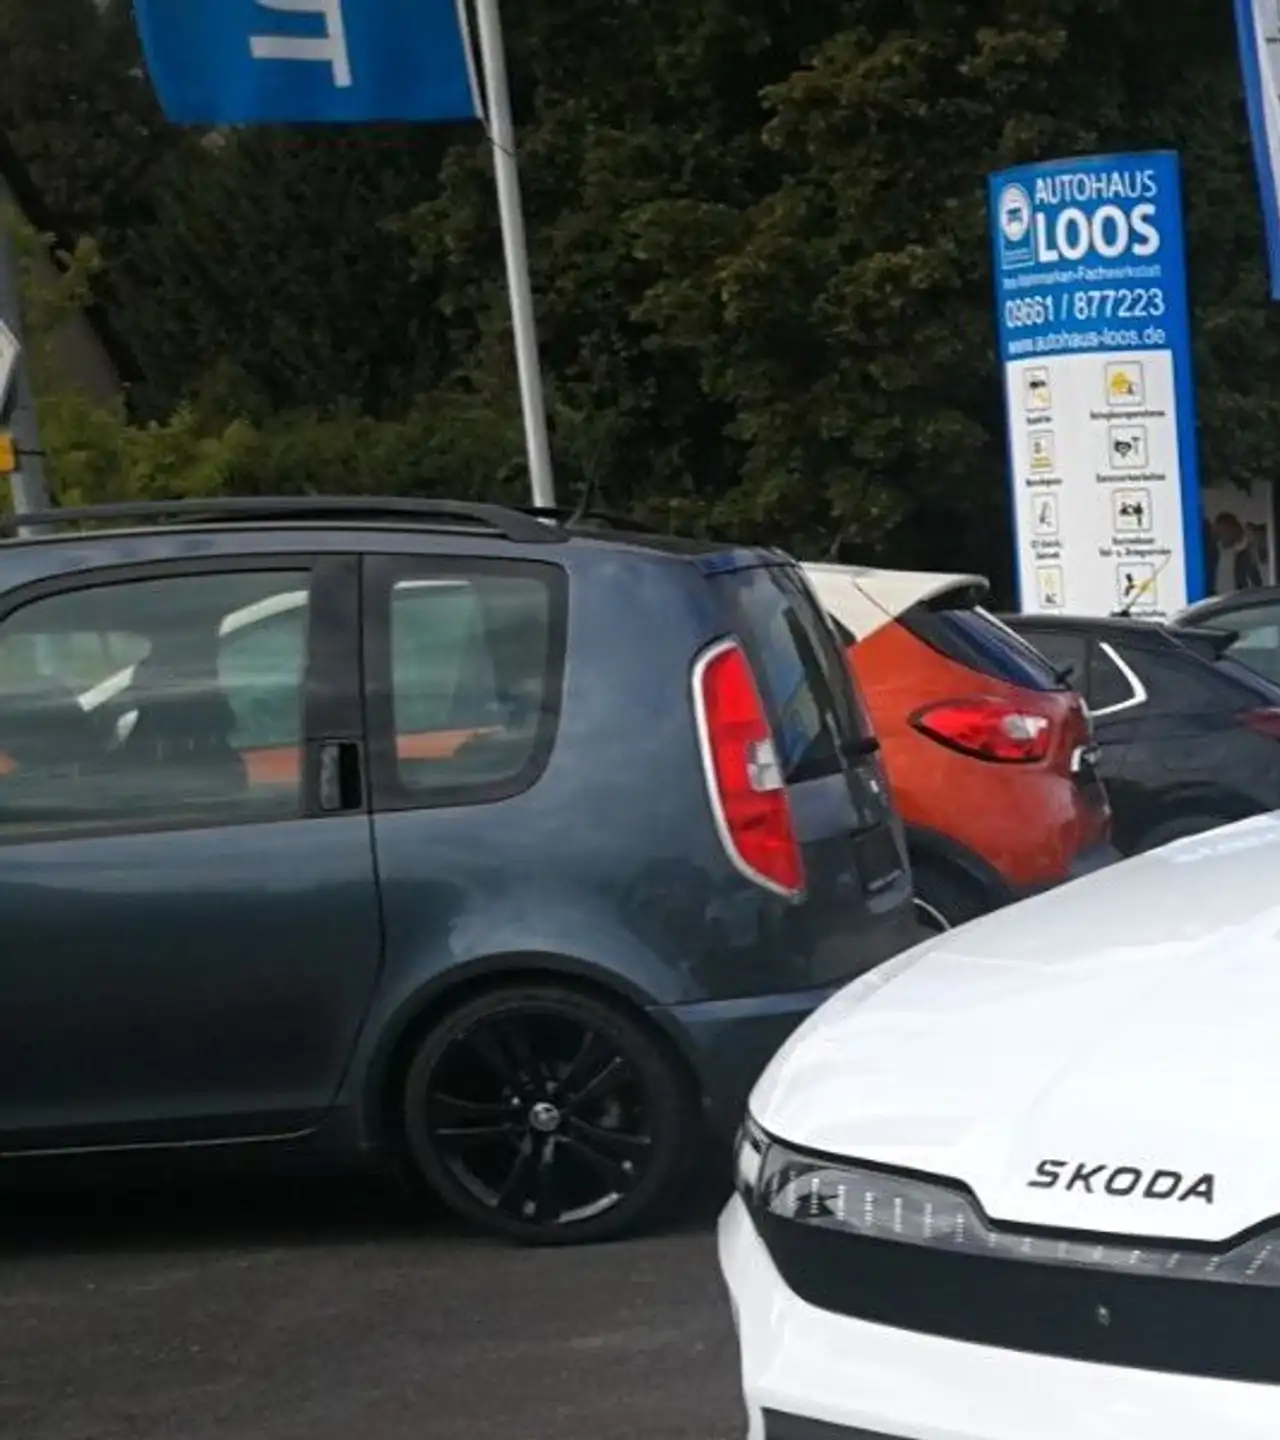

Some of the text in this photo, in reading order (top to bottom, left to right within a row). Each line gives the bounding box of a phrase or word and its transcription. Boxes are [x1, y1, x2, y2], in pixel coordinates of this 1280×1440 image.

[1035, 170, 1158, 204] AUTOHAUS
[1036, 202, 1161, 264] LOOS
[1005, 288, 1166, 328] 09661 / 877223
[1027, 1158, 1216, 1206] SKODA
